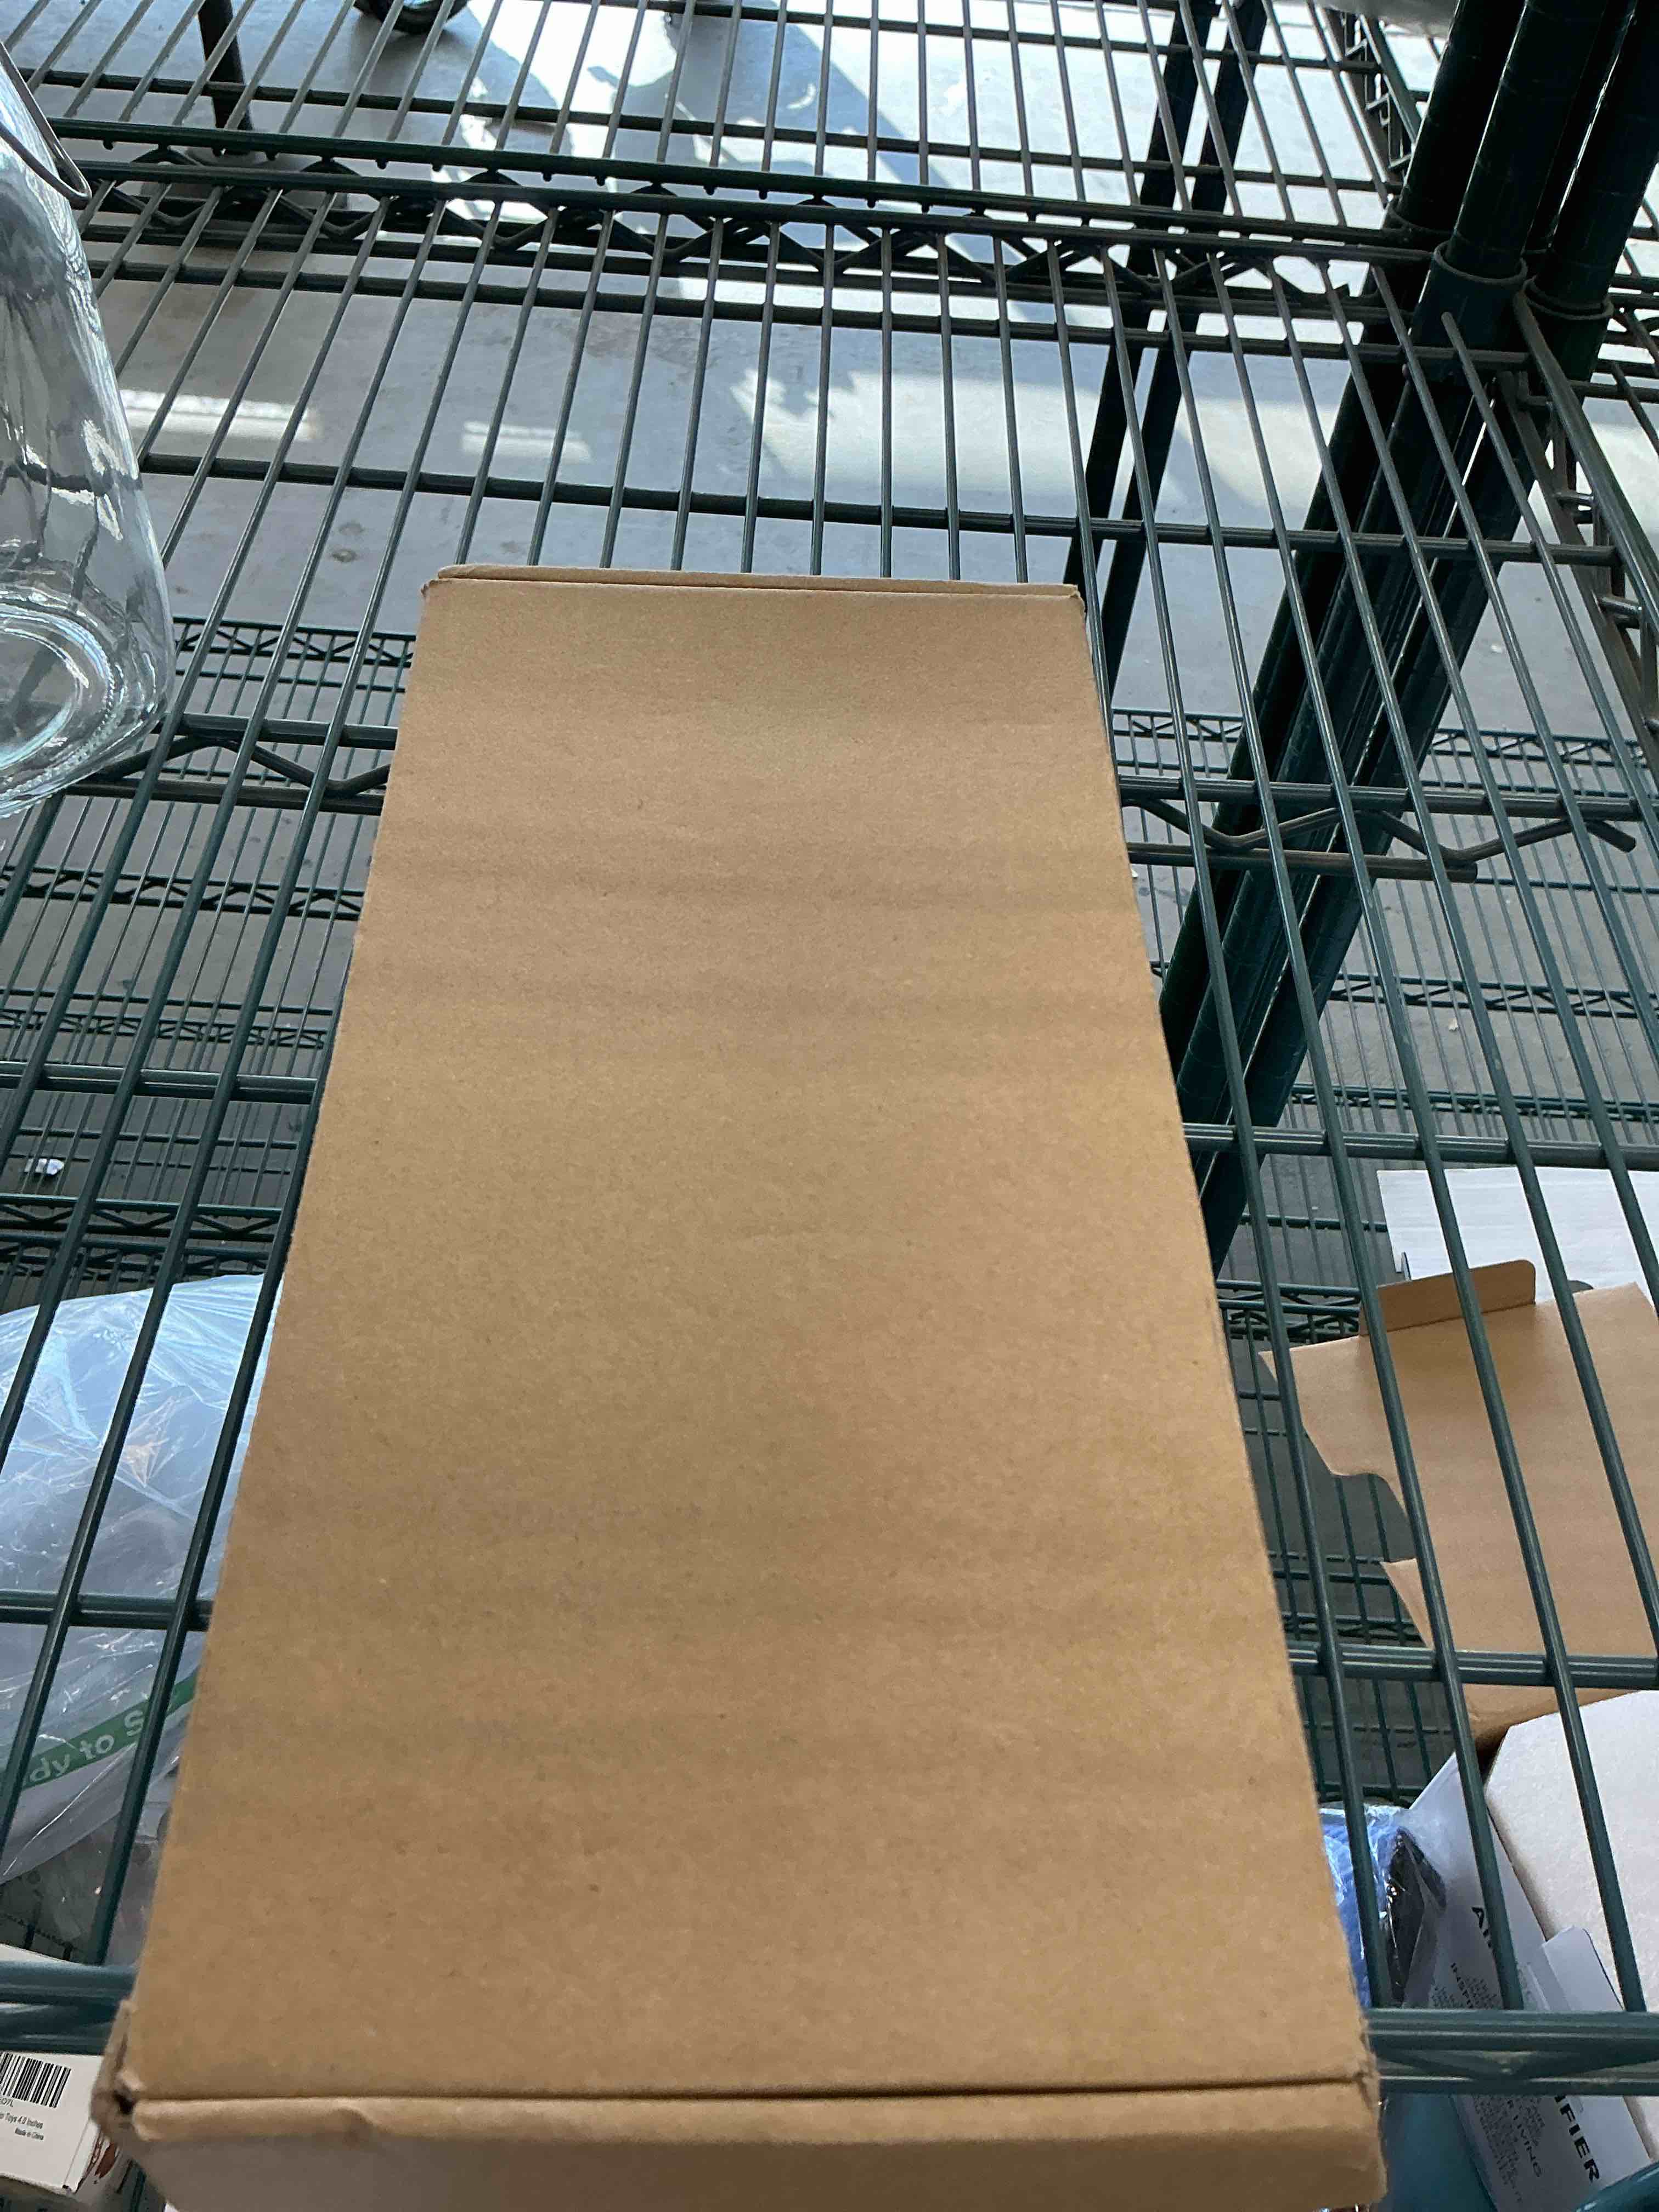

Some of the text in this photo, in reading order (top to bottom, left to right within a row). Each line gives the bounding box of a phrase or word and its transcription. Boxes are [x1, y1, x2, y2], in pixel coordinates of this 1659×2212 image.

[30, 1709, 145, 1782] dy to S
[1554, 2095, 1600, 2182] IFIER
